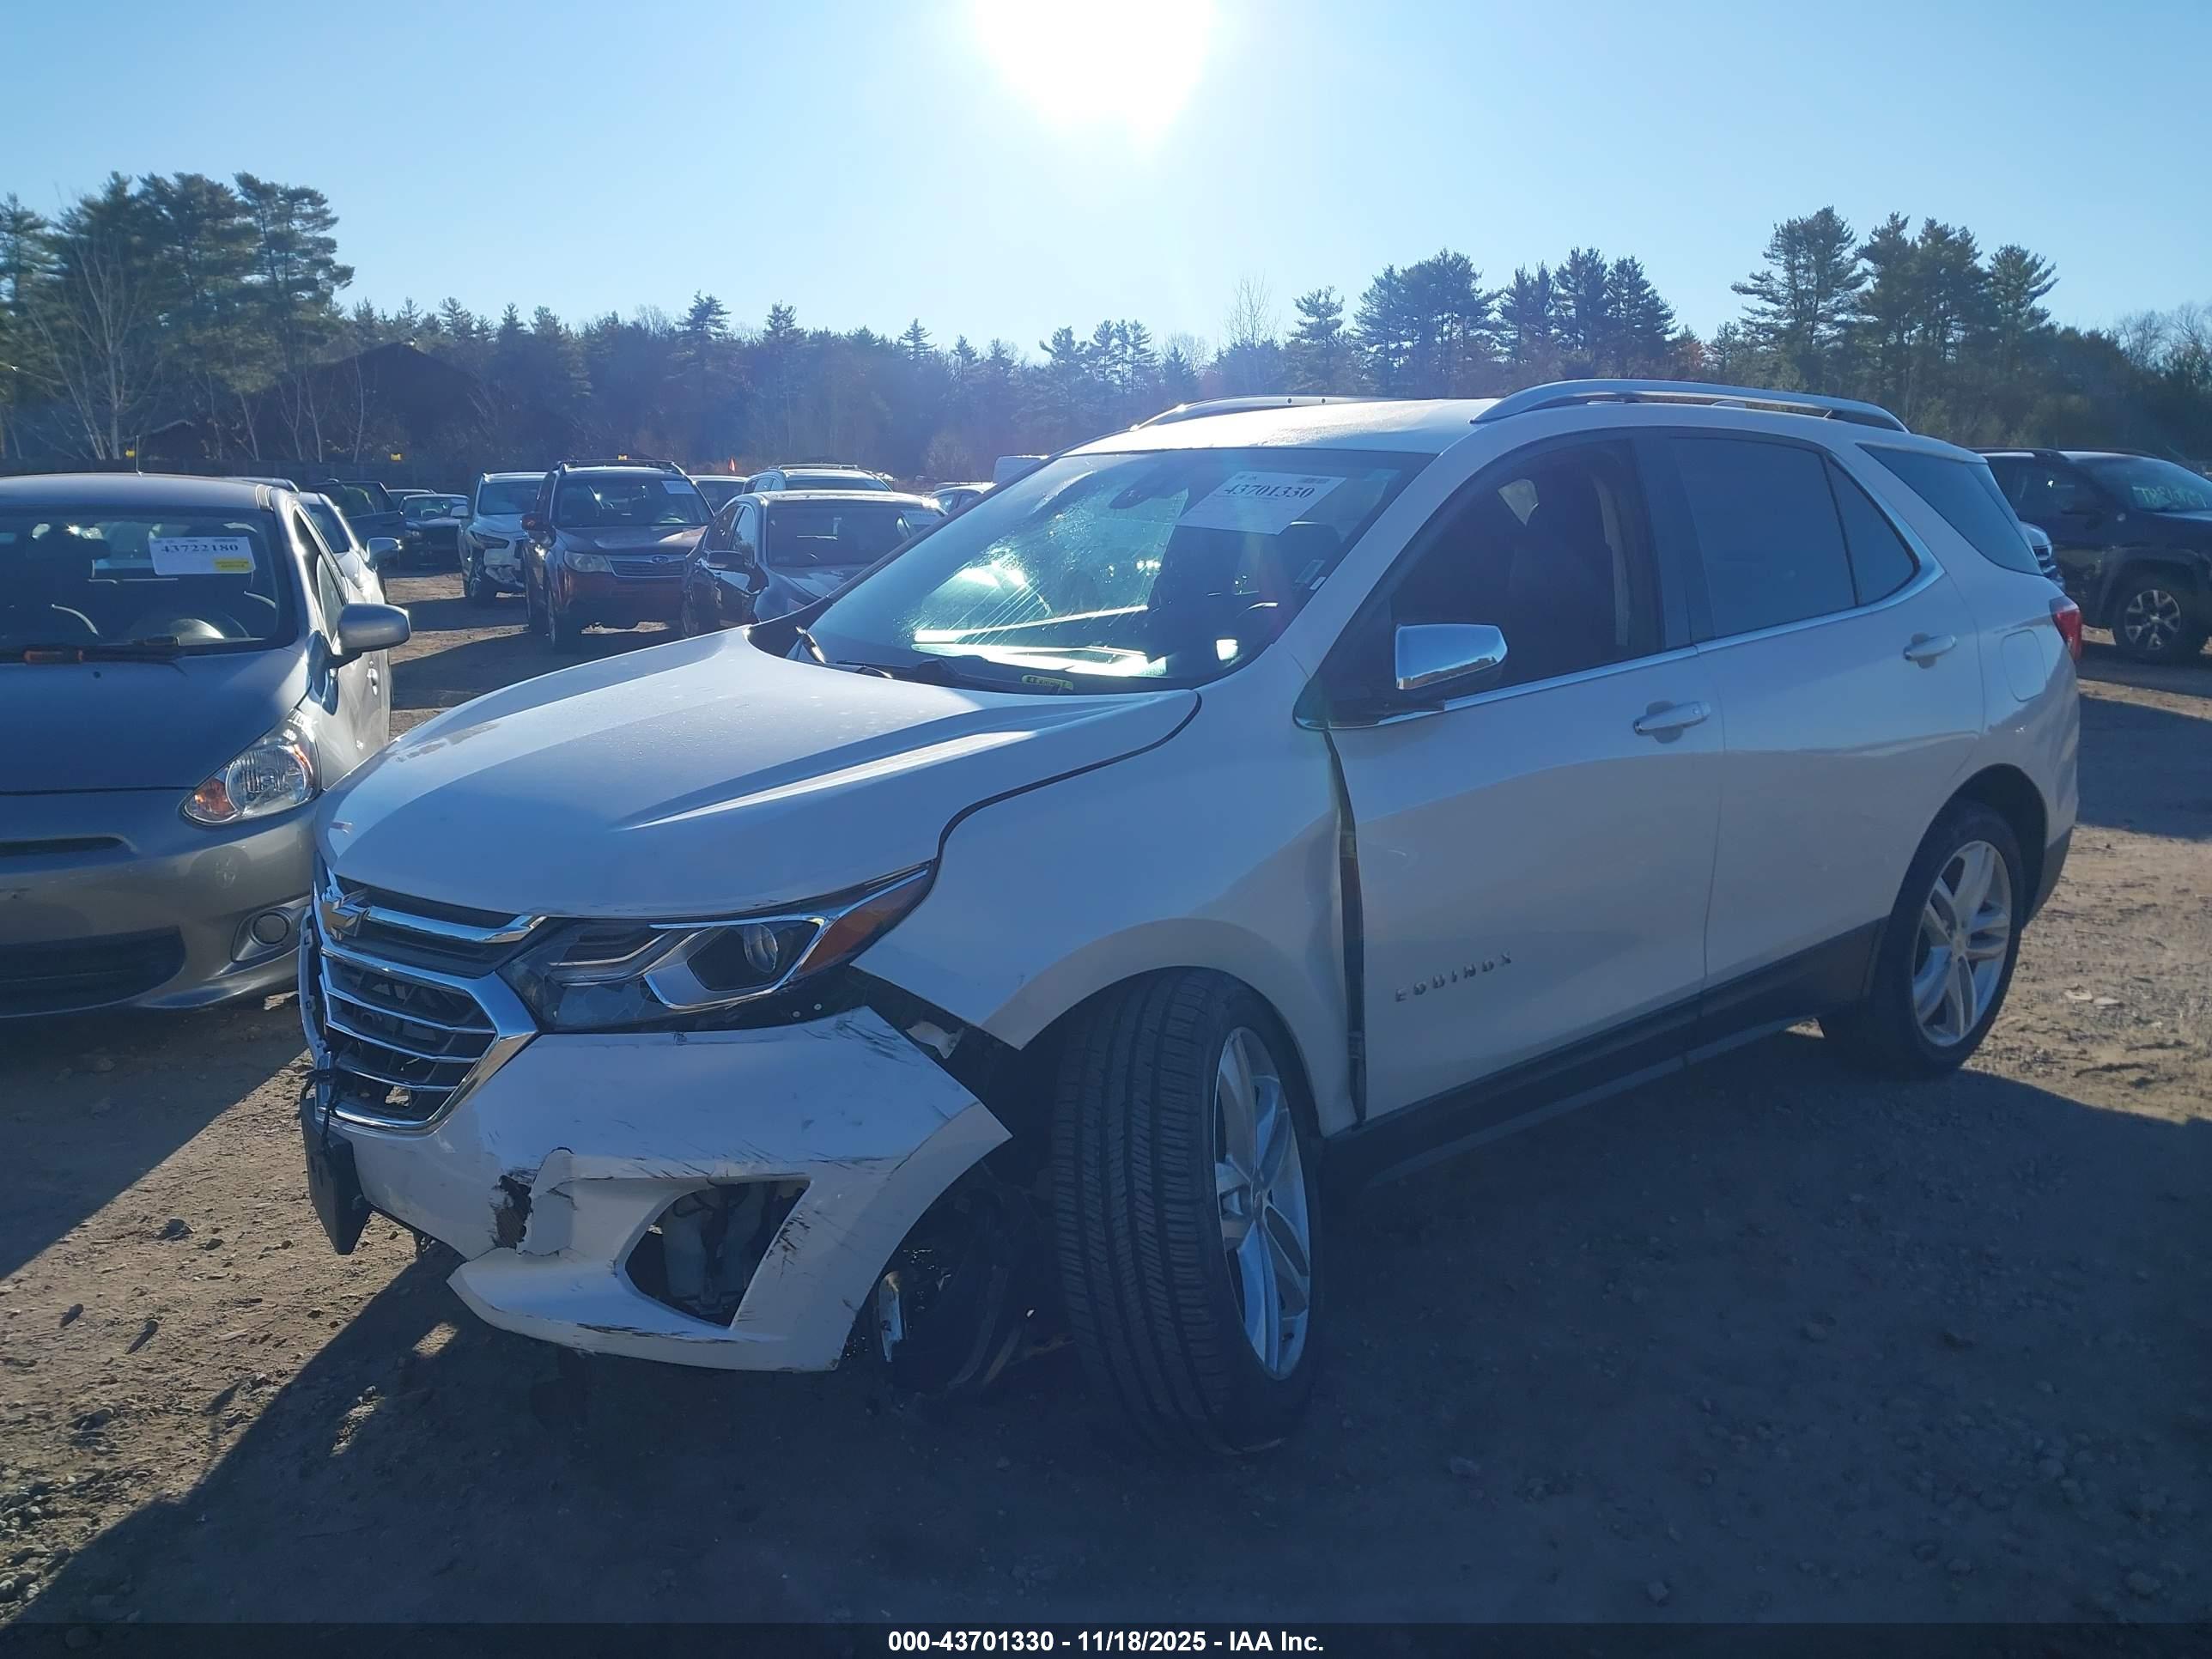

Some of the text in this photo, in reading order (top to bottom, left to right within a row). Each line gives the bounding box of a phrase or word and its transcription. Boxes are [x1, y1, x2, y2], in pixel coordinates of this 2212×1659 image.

[1224, 484, 1316, 498] 43701330
[161, 544, 240, 552] 43722180
[1395, 950, 1512, 1003] EQUINOX
